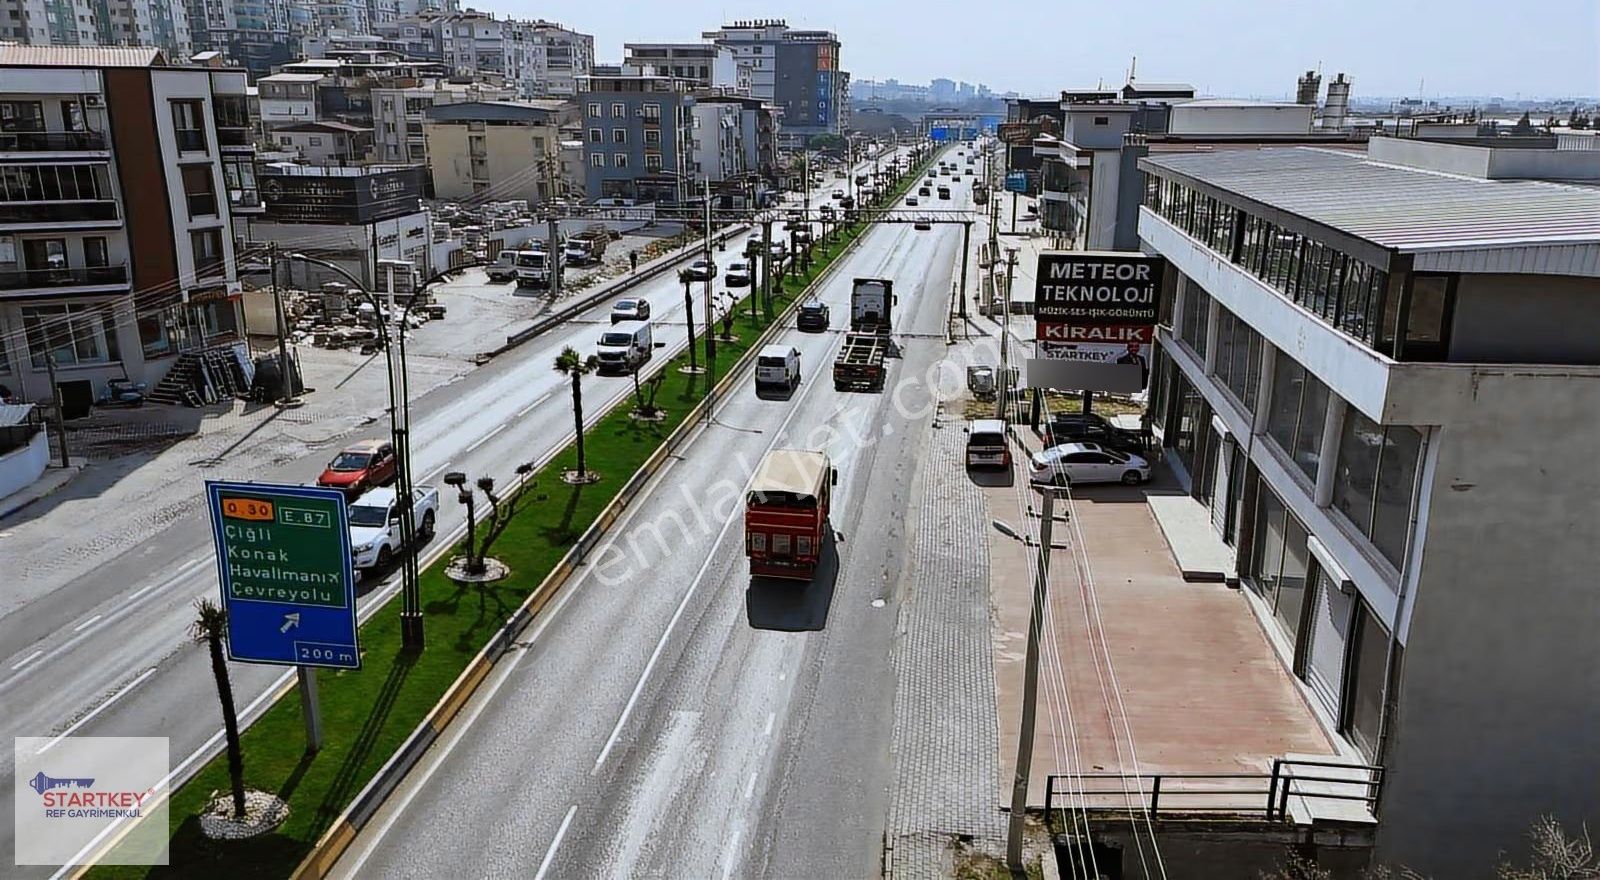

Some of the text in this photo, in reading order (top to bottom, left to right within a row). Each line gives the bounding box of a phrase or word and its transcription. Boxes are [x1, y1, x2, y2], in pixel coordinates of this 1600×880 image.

[1050, 262, 1151, 281] METEOR
[1042, 284, 1154, 303] TEKNOLOJİ
[1045, 323, 1144, 340] KİRALIK
[1047, 351, 1108, 360] STARTKEY
[285, 511, 325, 524] E.87
[228, 545, 289, 562] Konak
[232, 582, 331, 601] Çevreyolu
[301, 648, 353, 661] 200 m
